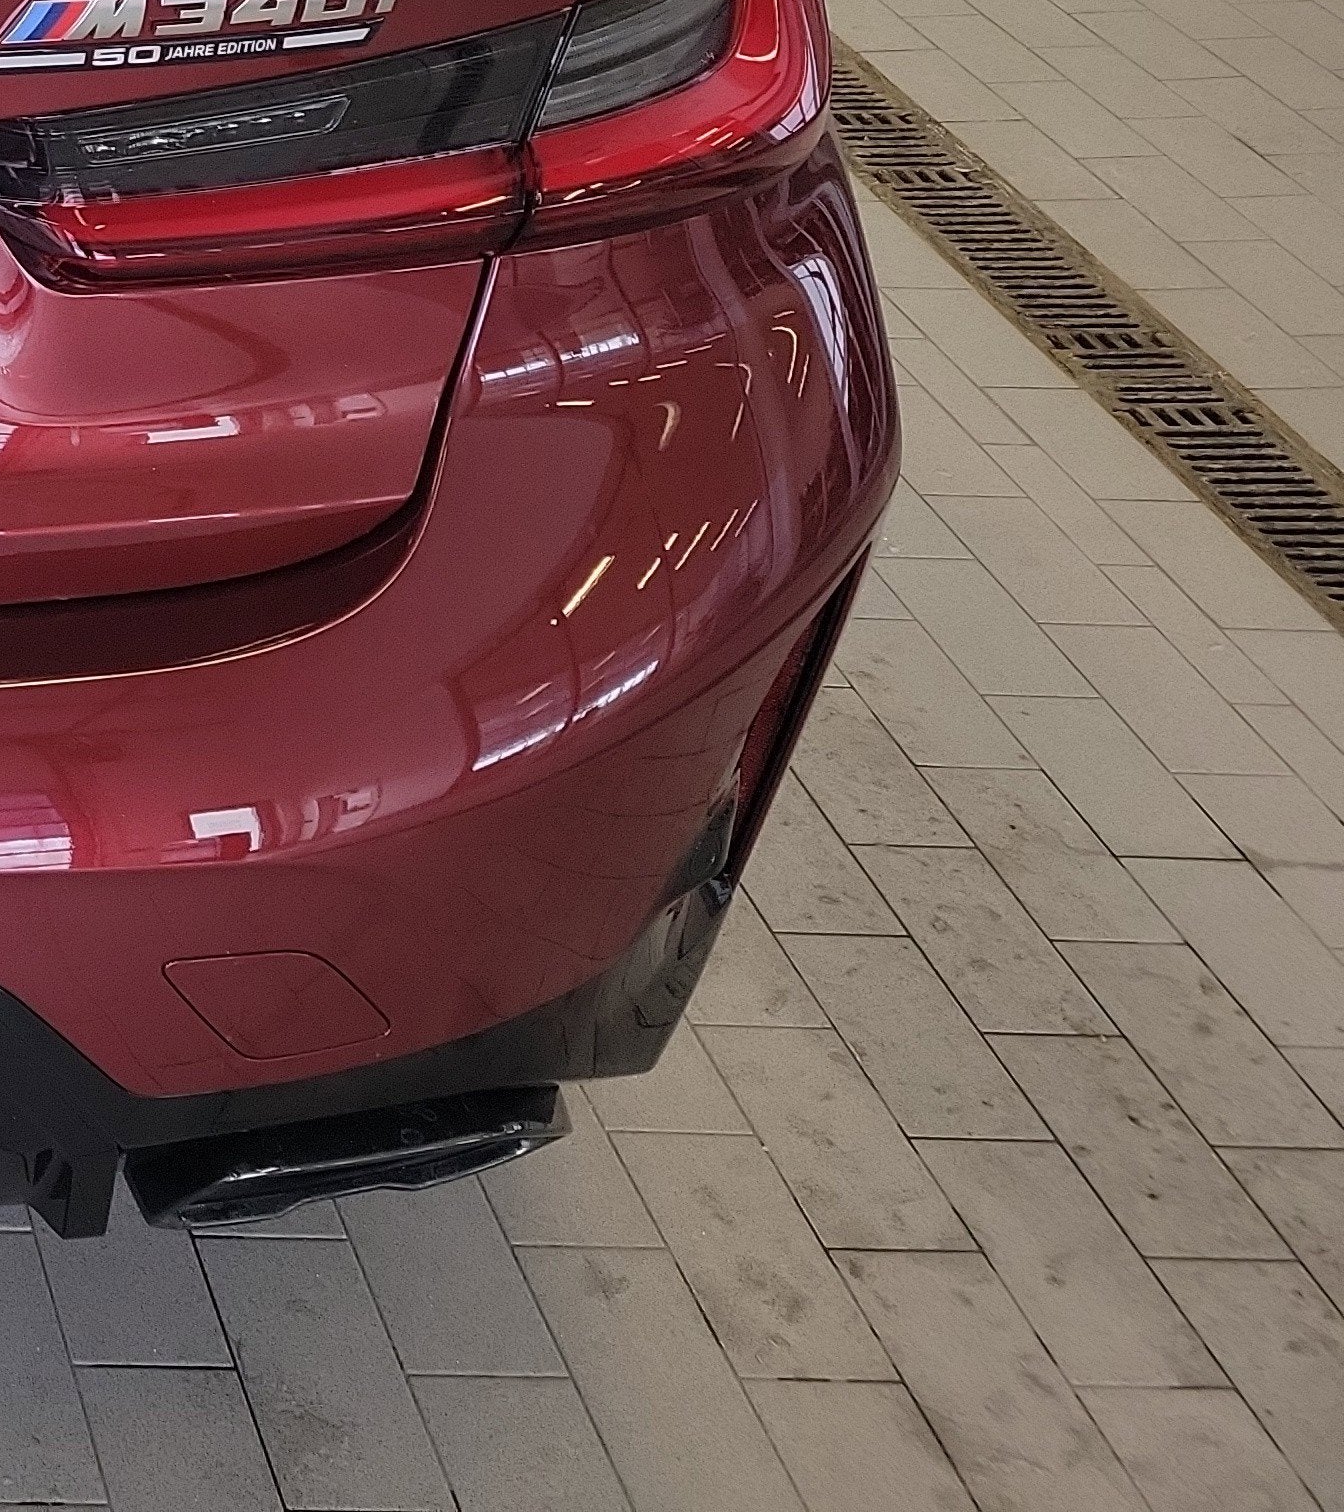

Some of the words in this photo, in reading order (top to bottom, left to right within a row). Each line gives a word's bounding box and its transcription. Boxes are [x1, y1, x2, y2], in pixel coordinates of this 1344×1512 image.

[91, 46, 161, 67] 50
[165, 41, 215, 62] JAHRE
[217, 37, 278, 57] EDITION
